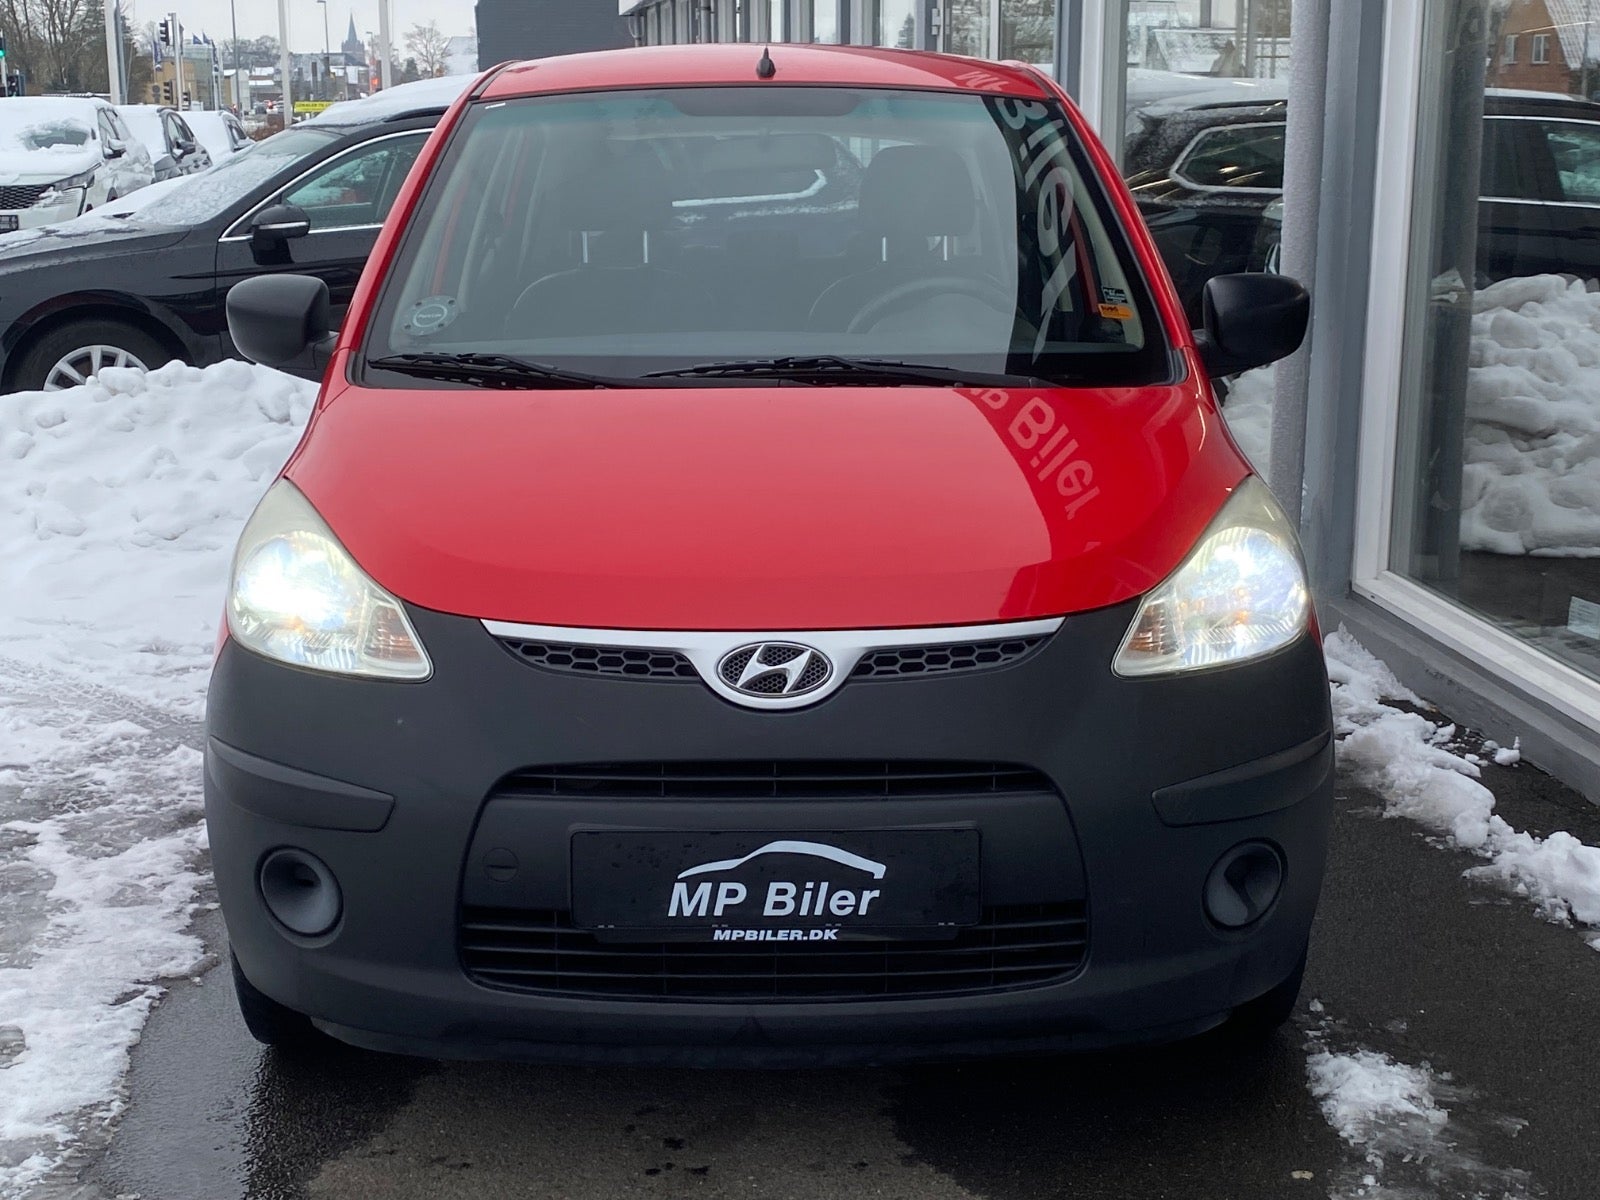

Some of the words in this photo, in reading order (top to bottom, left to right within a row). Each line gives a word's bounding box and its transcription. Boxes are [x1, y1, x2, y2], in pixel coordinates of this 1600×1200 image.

[667, 881, 748, 917] MP
[762, 881, 881, 917] Biler
[713, 929, 839, 941] MPBILER.DK
